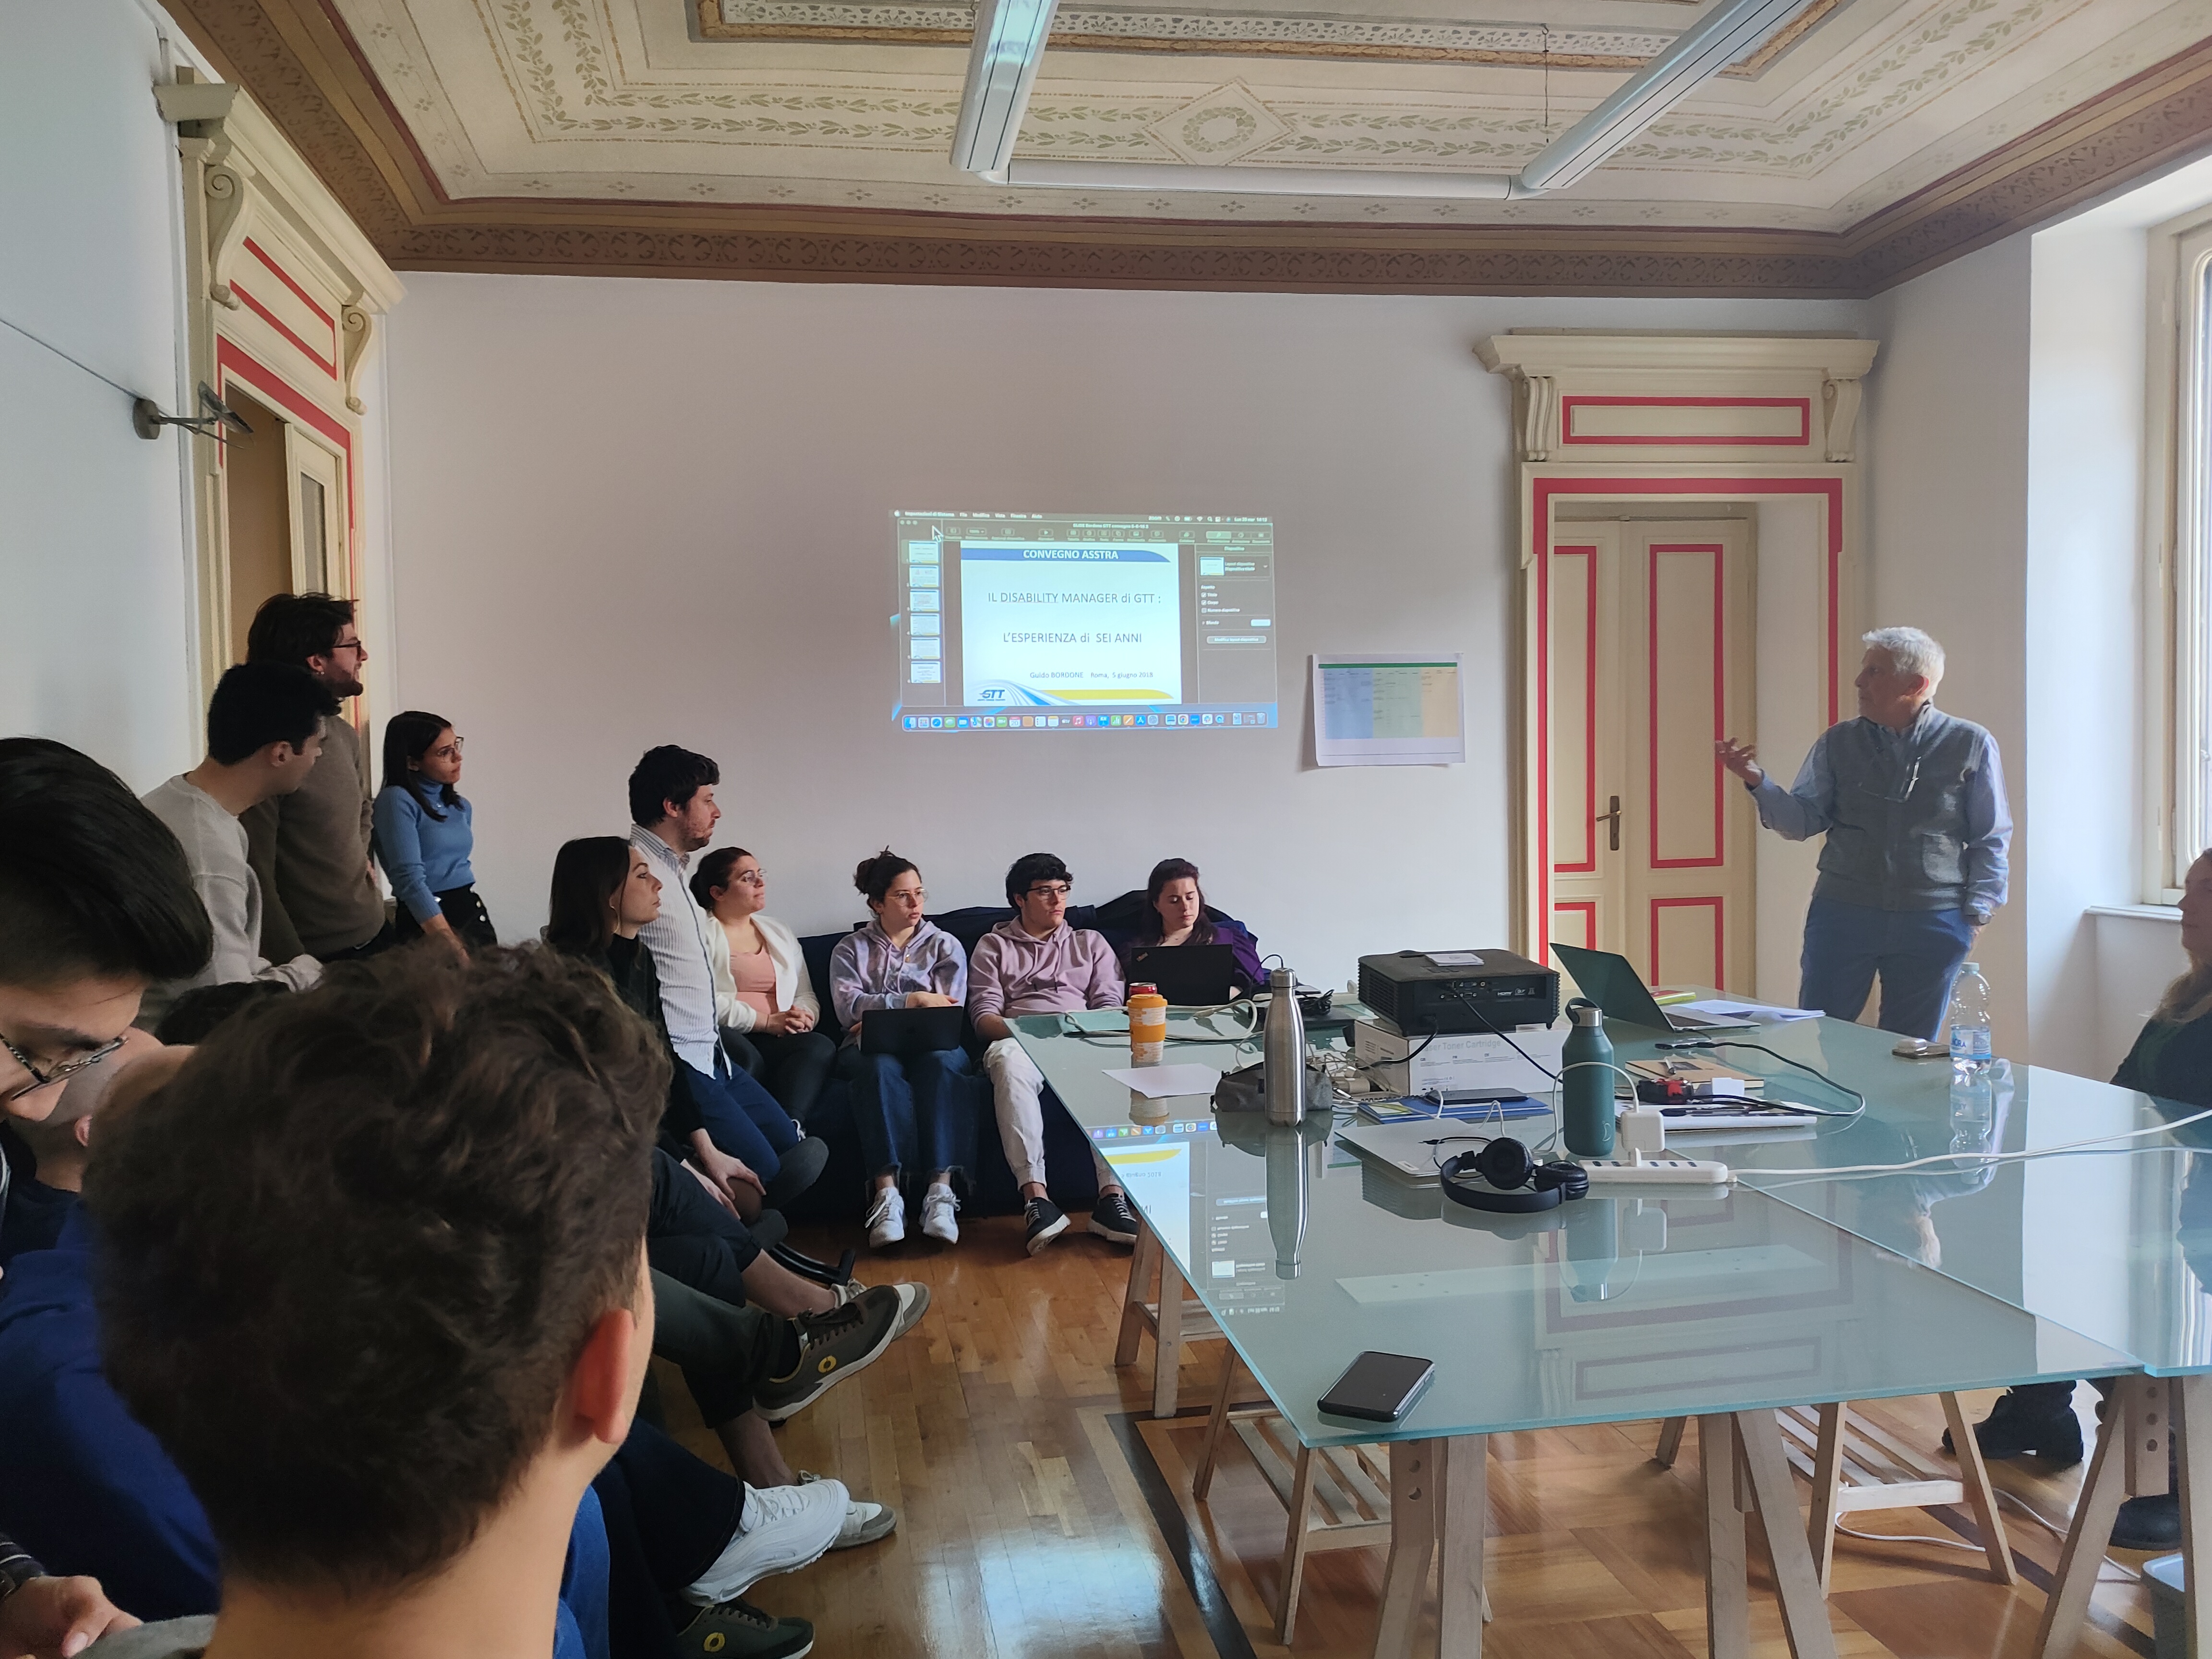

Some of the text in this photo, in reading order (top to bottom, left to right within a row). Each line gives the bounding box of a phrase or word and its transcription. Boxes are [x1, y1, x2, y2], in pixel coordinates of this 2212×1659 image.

[1023, 550, 1119, 559] CONVEGNO ASSTRA
[988, 593, 997, 602] IL
[1000, 593, 1058, 602] DISABILITY
[1062, 593, 1118, 603] MANAGER
[1121, 593, 1130, 603] di
[1134, 594, 1154, 603] GTT
[1080, 633, 1090, 643] di
[1096, 633, 1111, 642] SEI
[1115, 633, 1142, 643] ANNI
[979, 689, 1005, 698] GTT
[1466, 1039, 1501, 1048] Cartridge
